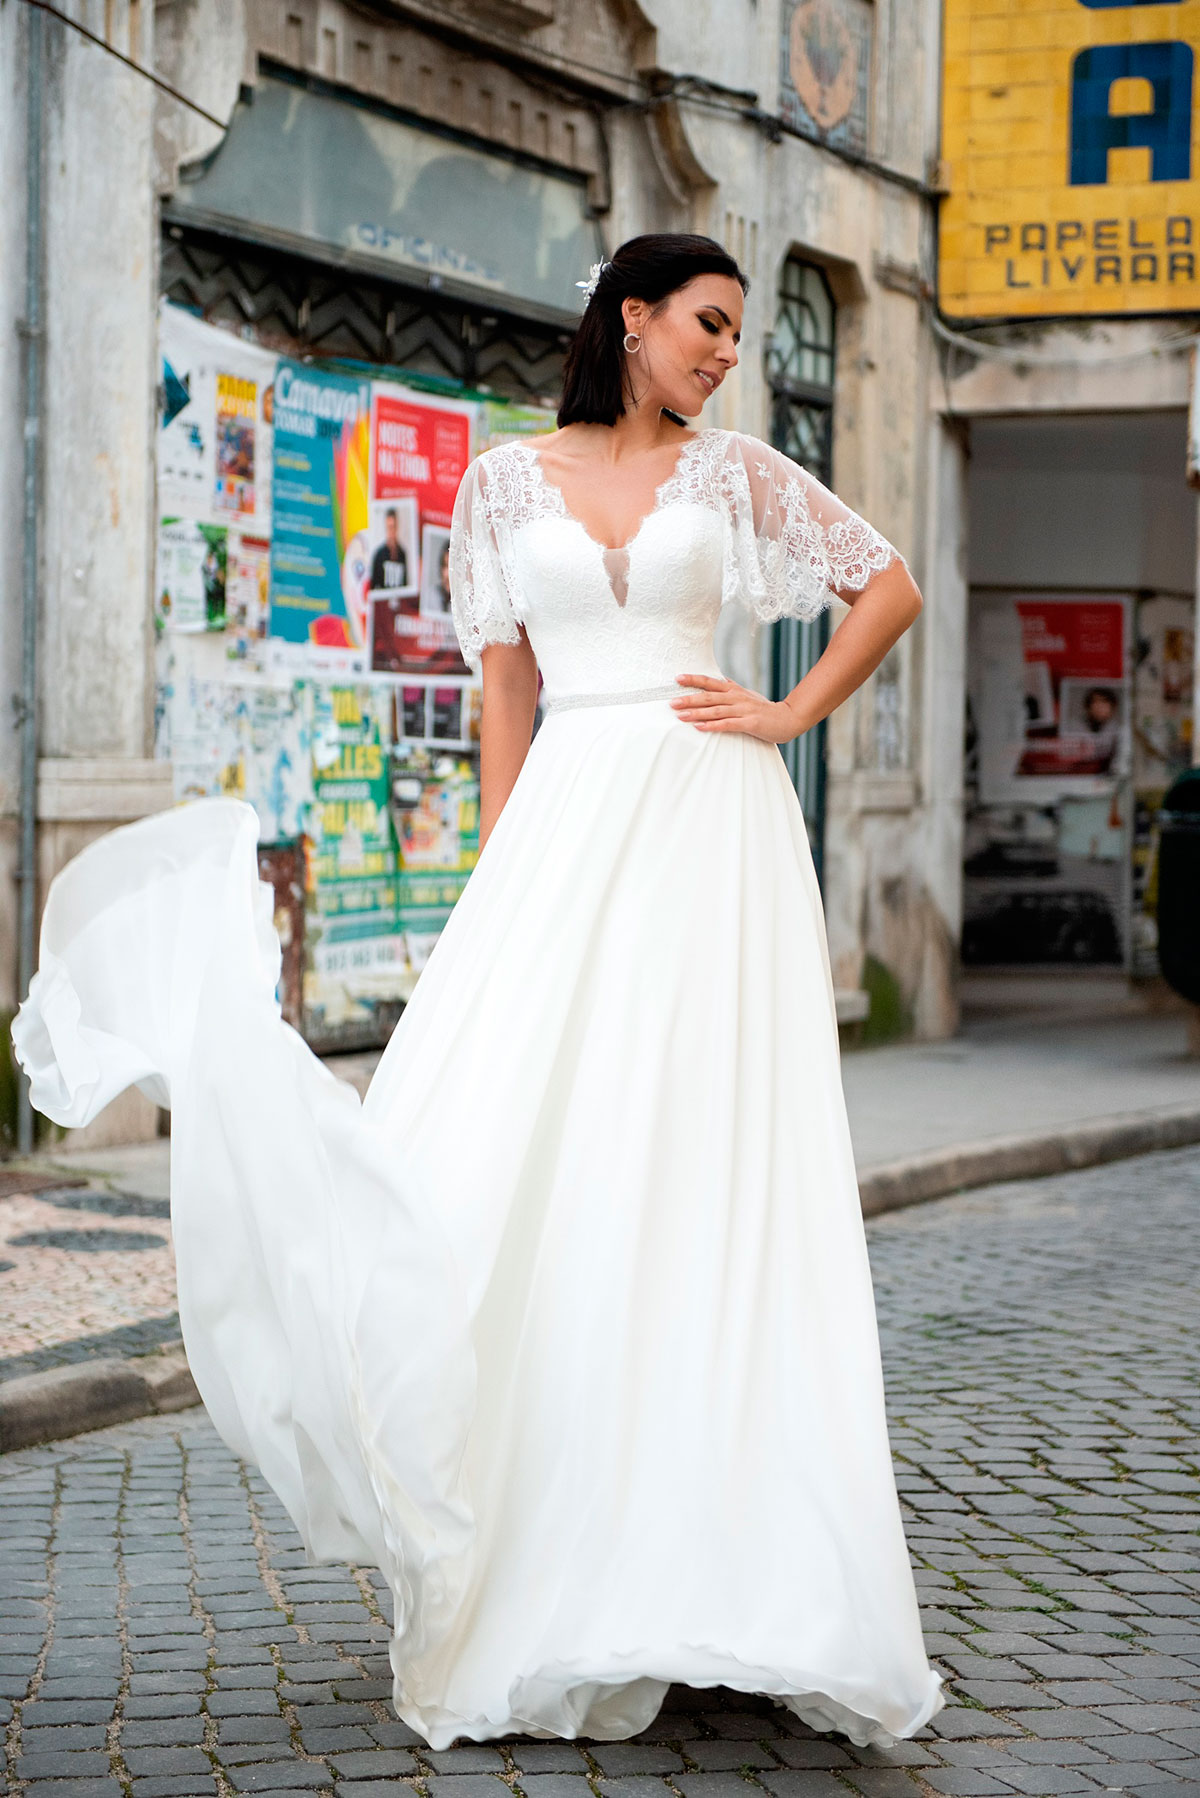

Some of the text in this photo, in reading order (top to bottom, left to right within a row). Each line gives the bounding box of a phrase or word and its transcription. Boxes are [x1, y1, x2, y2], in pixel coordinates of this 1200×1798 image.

[1069, 40, 1194, 186] A
[985, 215, 1192, 254] PAPELA
[1005, 252, 1195, 288] LIVRAR
[274, 366, 369, 424] Carnaval
